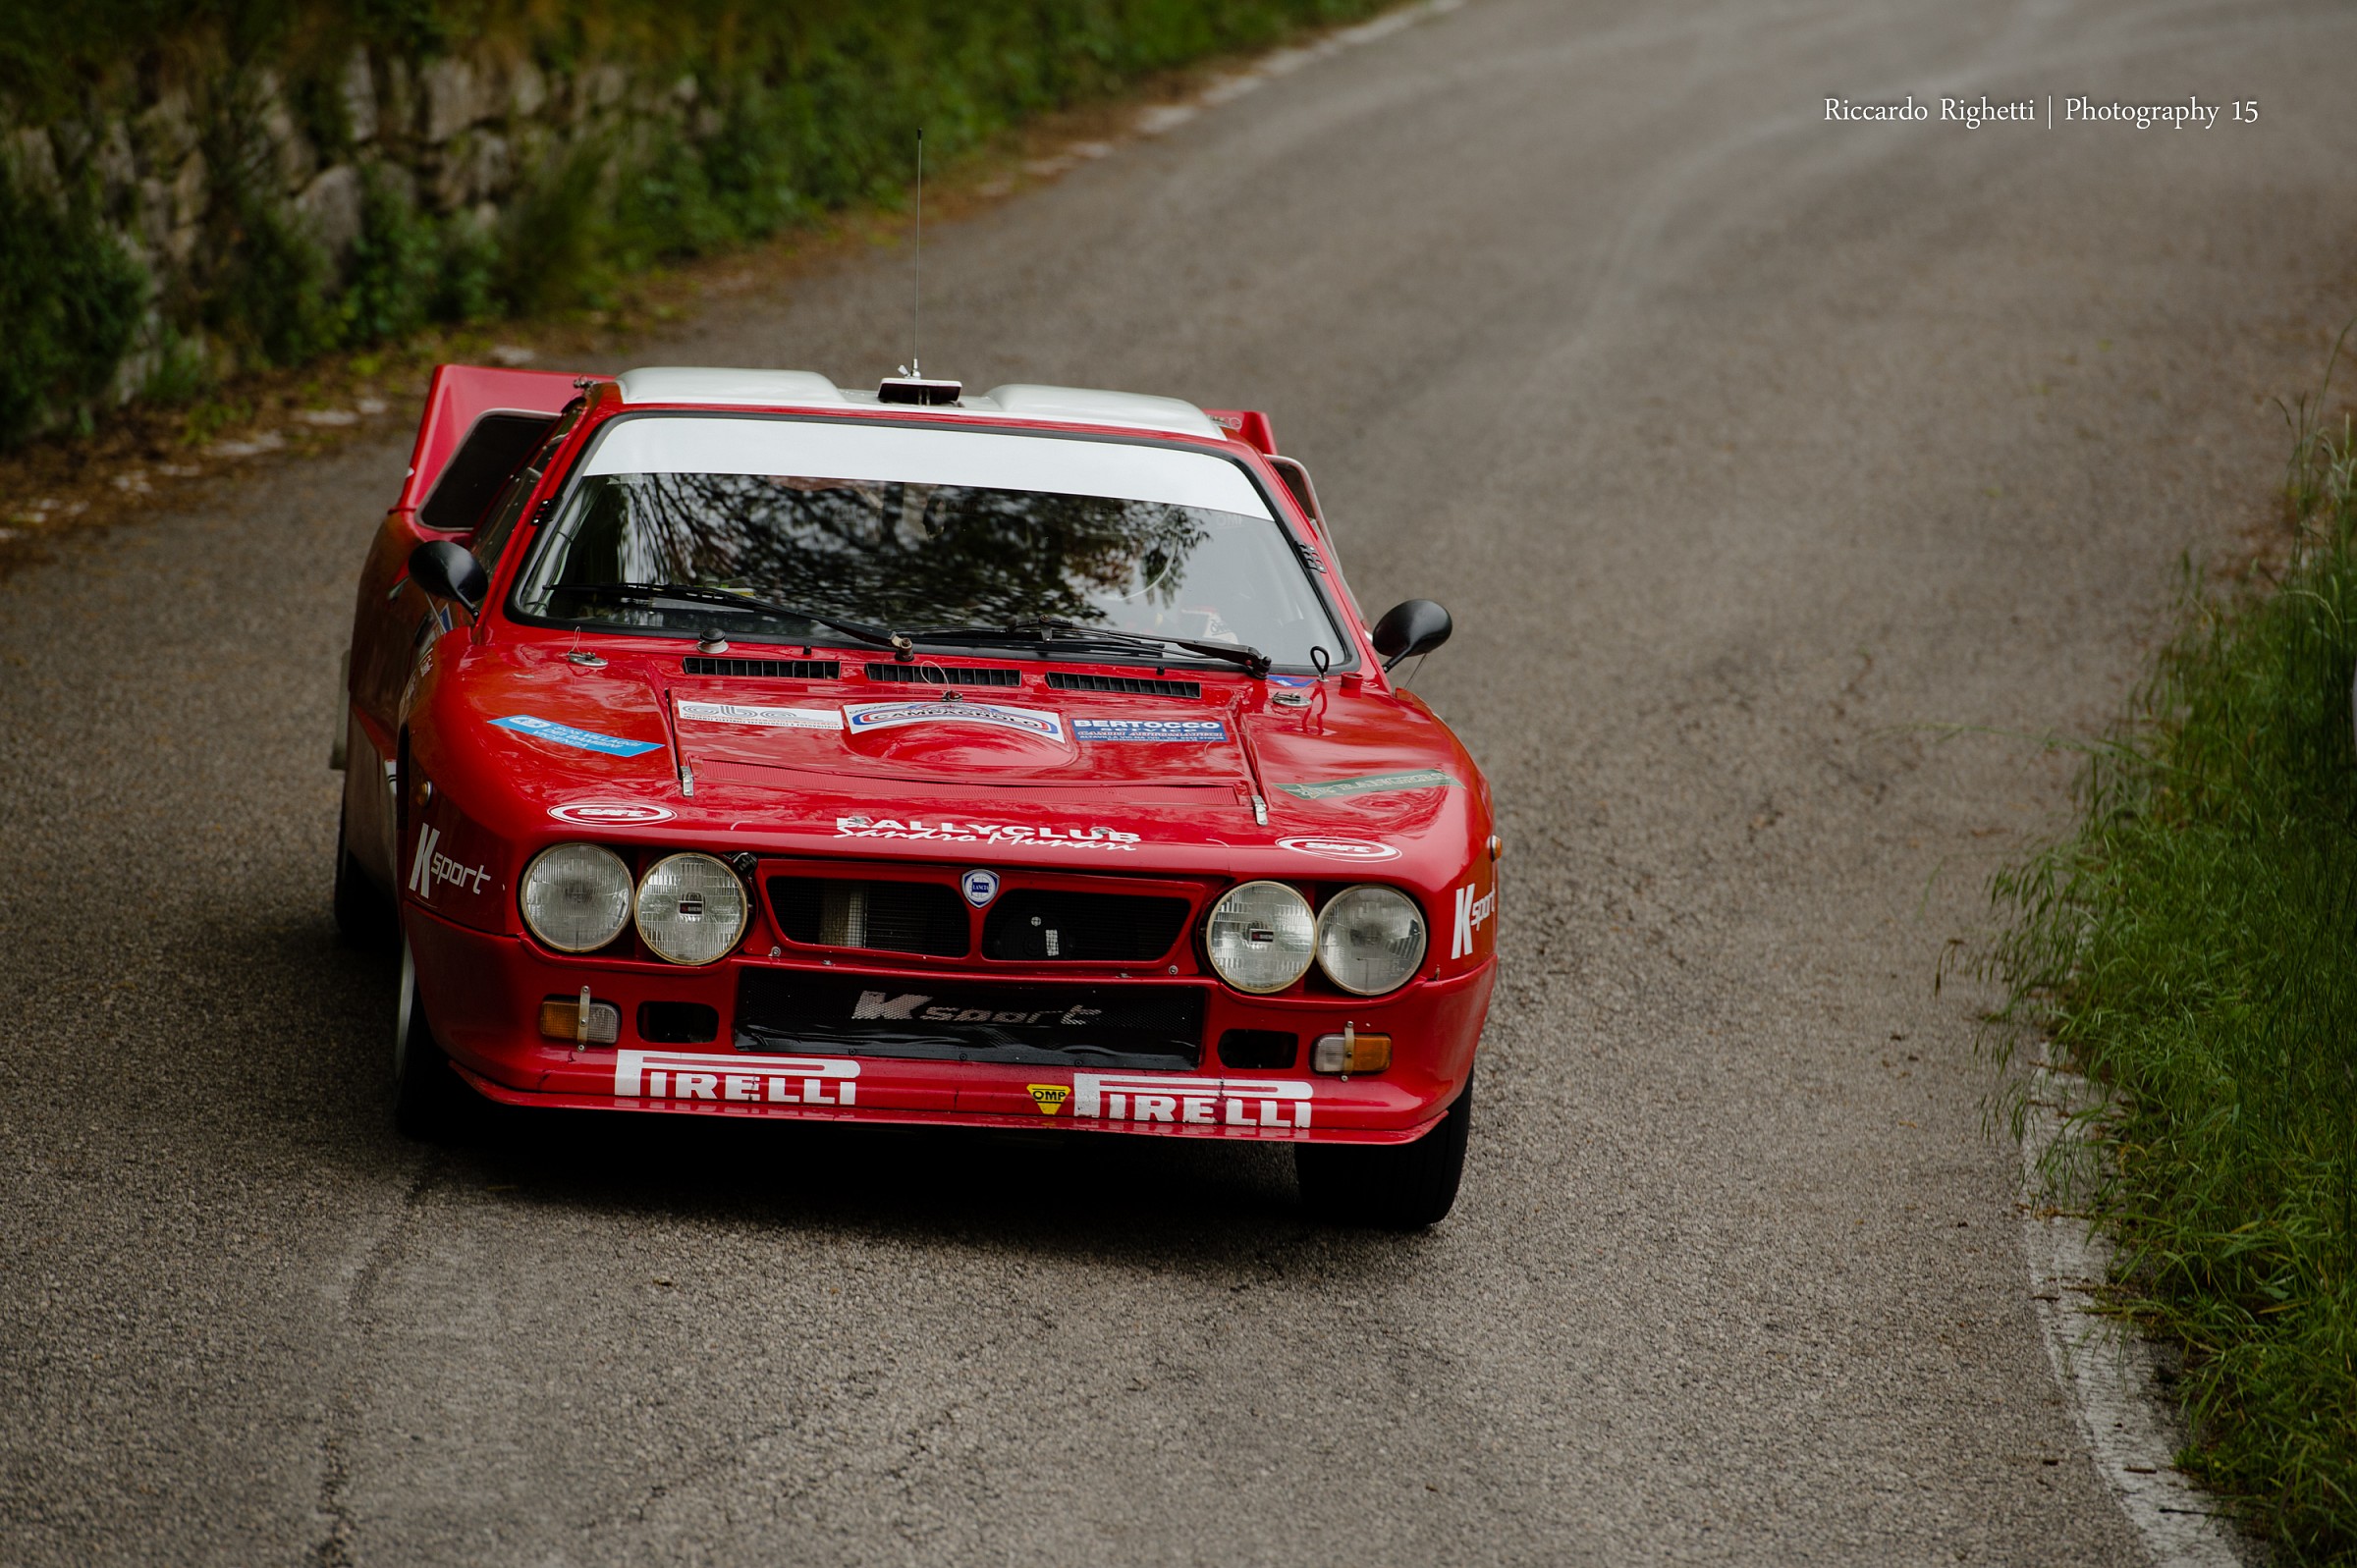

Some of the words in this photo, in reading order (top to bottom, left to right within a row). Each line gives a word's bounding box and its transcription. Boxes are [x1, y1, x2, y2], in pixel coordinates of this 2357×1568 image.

[874, 710, 1039, 728] CAMPAGNOLO
[1073, 720, 1221, 730] BERTOCCO
[583, 732, 642, 747] VILLAGGI
[834, 826, 977, 841] Sandro
[987, 831, 1137, 851] Munari
[615, 1049, 861, 1106] PIRELLI
[1032, 1090, 1067, 1102] OMP
[1073, 1073, 1314, 1128] PIRELLI
